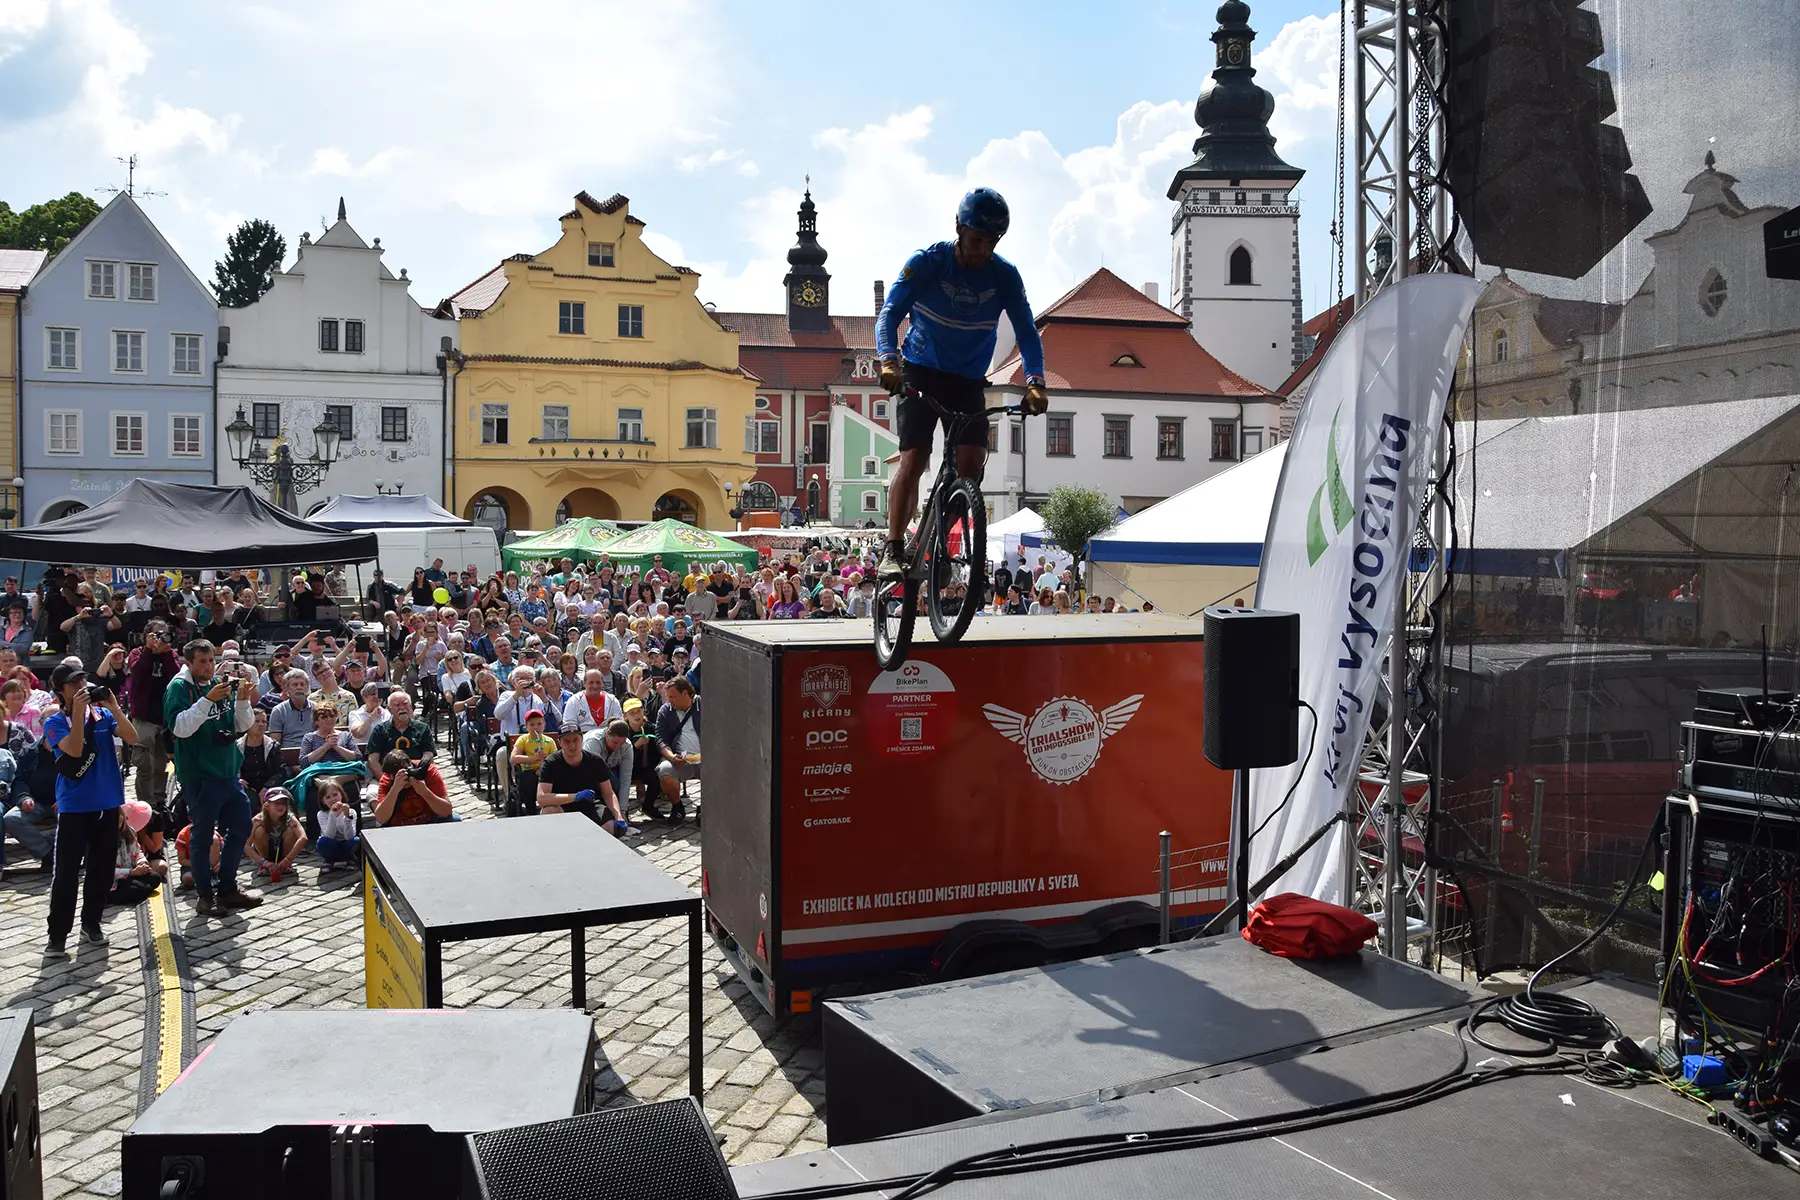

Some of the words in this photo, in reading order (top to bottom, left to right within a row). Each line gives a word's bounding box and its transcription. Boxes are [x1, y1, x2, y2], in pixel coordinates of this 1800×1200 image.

[896, 678, 928, 686] BikePlan
[892, 694, 932, 703] PARTNER
[1030, 721, 1095, 748] TRIALSHOW
[1044, 734, 1087, 752] IMPOSSIBLE
[75, 752, 96, 778] adidas
[803, 762, 842, 776] maloja
[1035, 757, 1048, 770] FUN
[1048, 766, 1058, 775] ON
[1059, 753, 1093, 776] OBSTACLES
[804, 787, 851, 797] LEZYNE
[813, 816, 852, 826] GATORADE
[803, 896, 854, 915] EXHIBICE
[856, 895, 872, 910] NA
[874, 890, 916, 908] KOLECH
[918, 888, 933, 904] OD
[935, 884, 976, 902] MISTRU
[977, 878, 1037, 897] REPUBLIKY
[1038, 877, 1045, 891] A
[1048, 874, 1079, 890] SVETA
